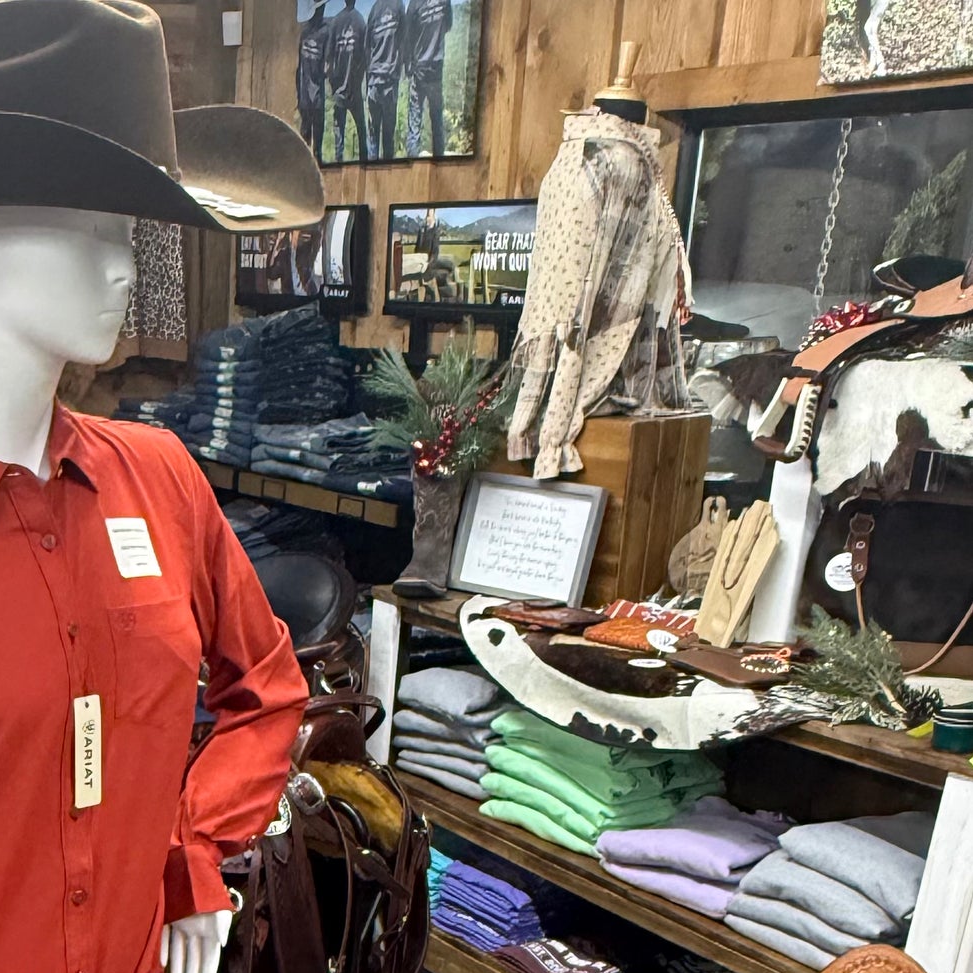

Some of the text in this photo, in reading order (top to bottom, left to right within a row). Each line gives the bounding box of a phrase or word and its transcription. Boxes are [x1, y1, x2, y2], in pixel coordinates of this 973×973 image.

[485, 231, 535, 250] GEAR THAT
[472, 252, 507, 271] WON'T
[508, 296, 524, 304] ARI
[84, 736, 94, 789] ARIAT
